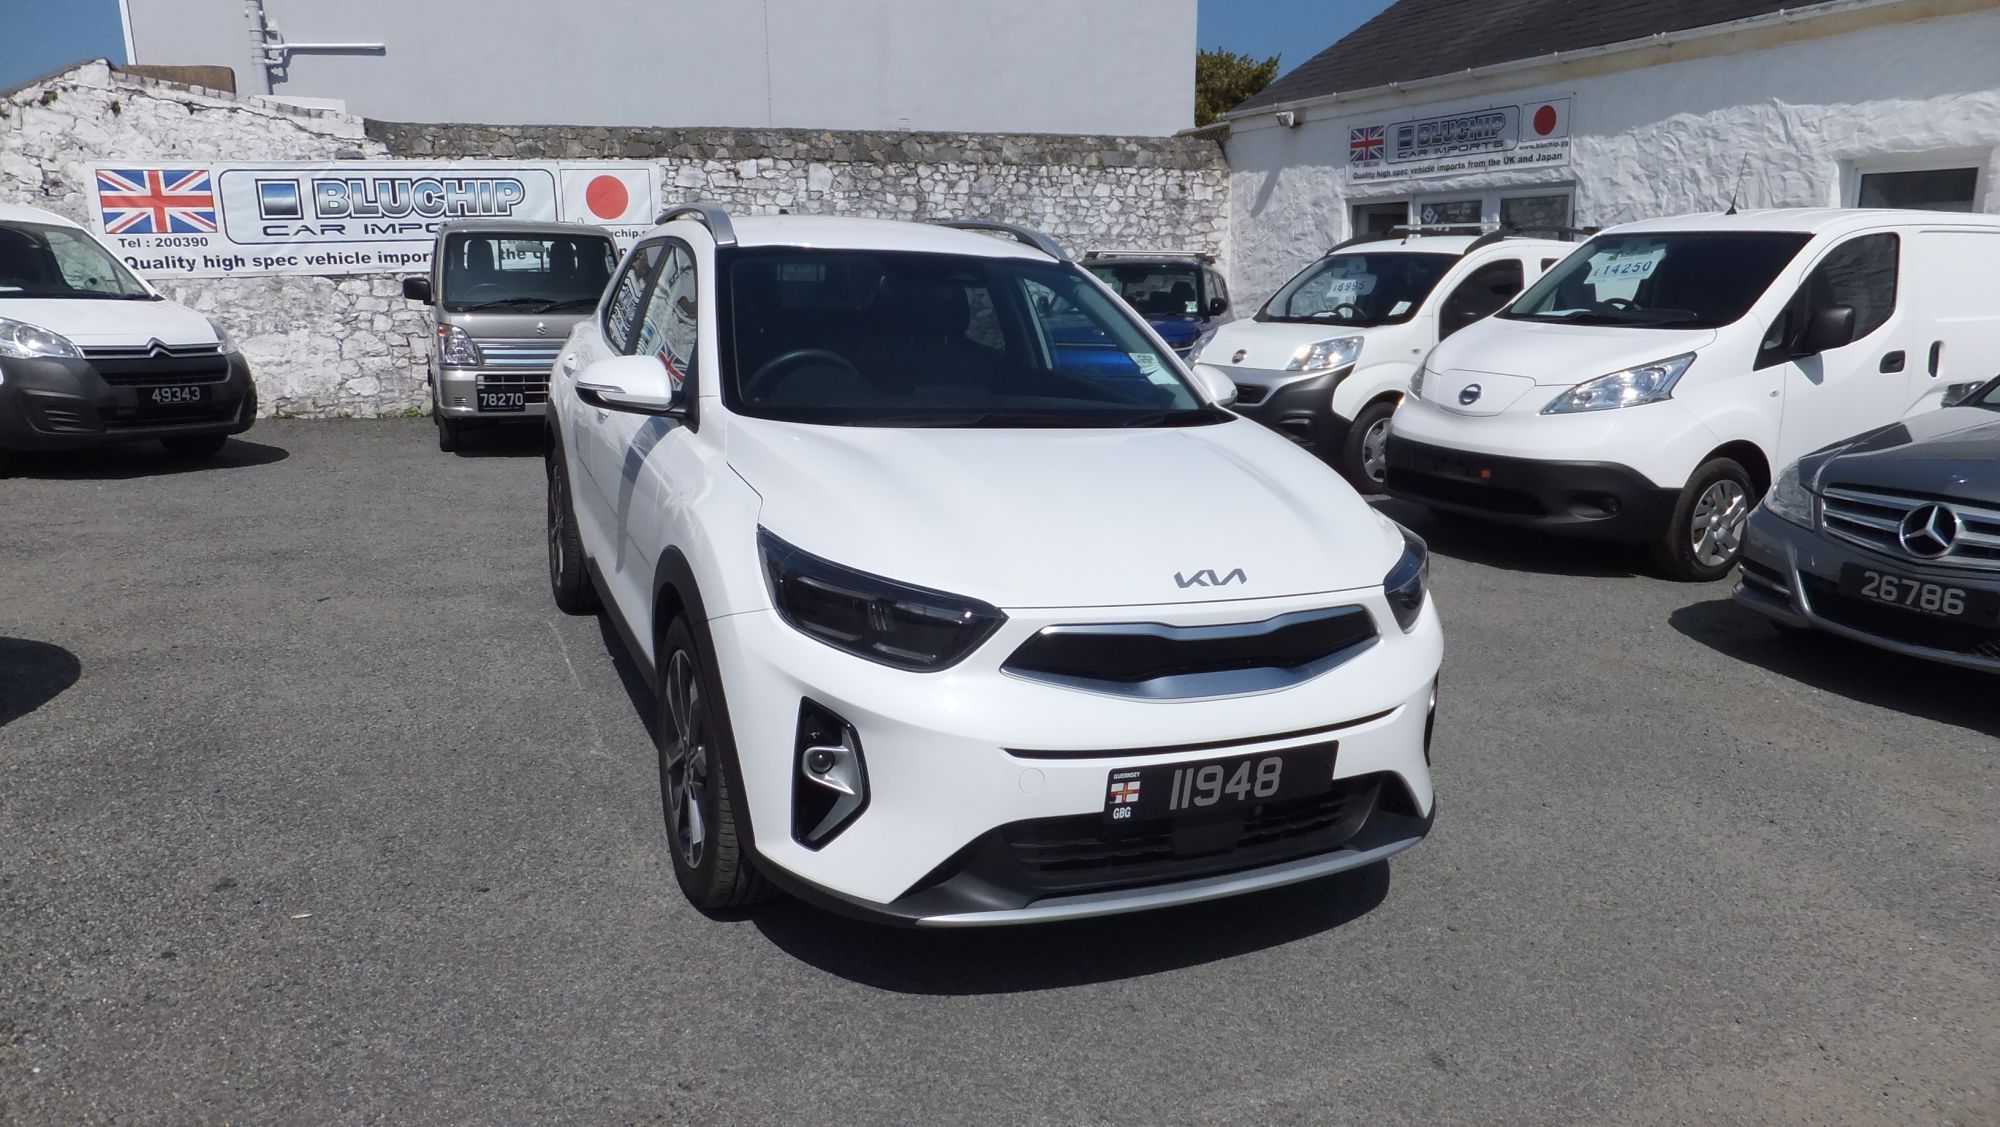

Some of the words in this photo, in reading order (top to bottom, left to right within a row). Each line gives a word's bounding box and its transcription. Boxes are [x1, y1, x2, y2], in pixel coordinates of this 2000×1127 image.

[1417, 112, 1505, 147] BLUCHIP
[1397, 150, 1428, 158] CAR
[1434, 140, 1504, 155] IMPORTS
[1352, 171, 1375, 180] Quality
[1376, 169, 1391, 178] high
[1393, 168, 1408, 177] spec
[1410, 165, 1434, 175] vehicle
[1437, 161, 1466, 171] imports
[1468, 160, 1486, 168] from
[1488, 158, 1501, 166] the
[1503, 156, 1516, 165] UK
[1518, 154, 1533, 163] and
[1536, 153, 1562, 162] Japan
[311, 177, 525, 220] BLUCHIP
[262, 224, 346, 236] CAR
[363, 222, 441, 235] IMPO
[118, 237, 141, 249] Tel
[155, 236, 209, 248] 200390
[124, 255, 196, 272] Quality
[203, 254, 246, 271] high
[252, 255, 299, 270] spec
[304, 251, 372, 266] vehicle
[378, 250, 433, 266] impor
[151, 386, 200, 402] 49343
[479, 393, 524, 407] 78270
[1861, 570, 1966, 615] 26786
[1113, 771, 1141, 780] GUERNSEY
[1169, 756, 1283, 811] 11948
[1113, 806, 1131, 819] GBG
